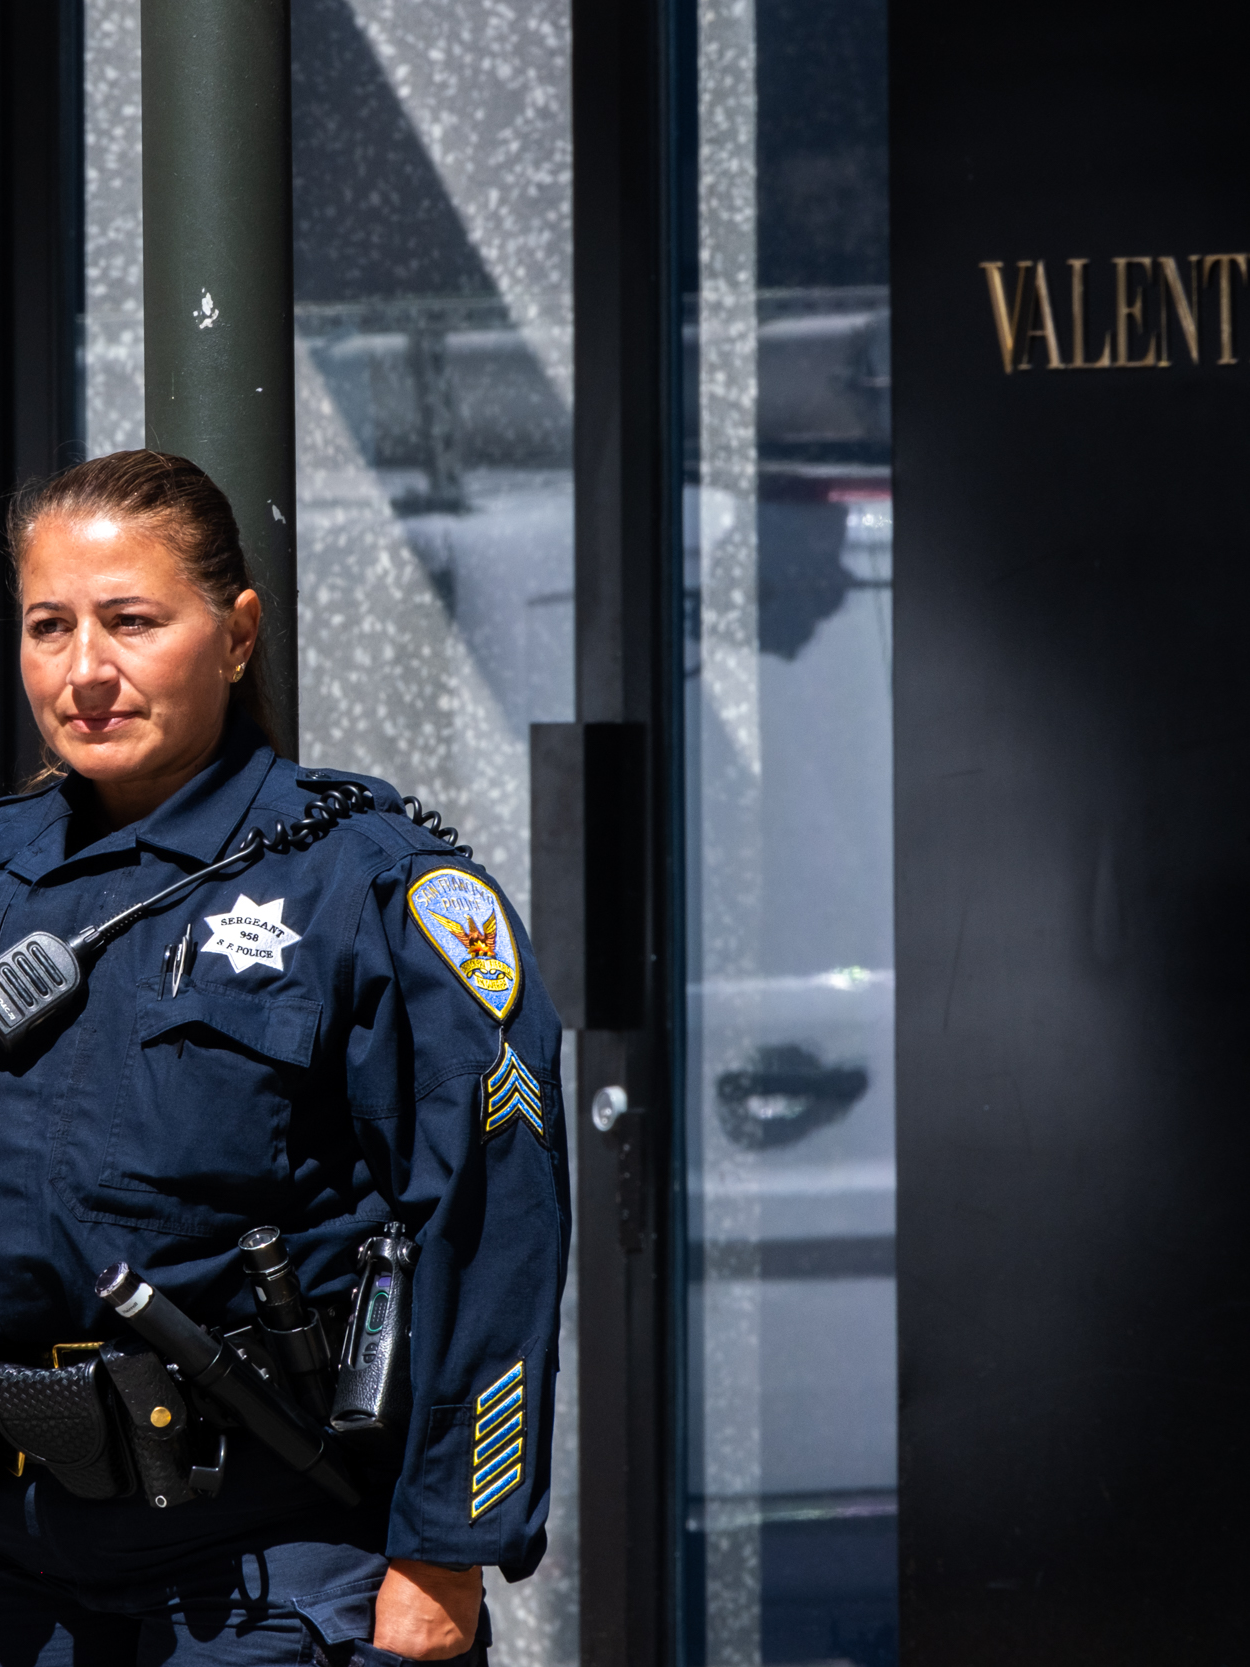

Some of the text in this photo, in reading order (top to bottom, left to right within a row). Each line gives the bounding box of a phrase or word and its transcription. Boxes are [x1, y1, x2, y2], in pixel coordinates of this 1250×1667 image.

[978, 254, 1250, 375] VALENT
[415, 882, 440, 907] SAN
[220, 916, 285, 939] SERGEANT
[239, 930, 260, 943] 958
[235, 945, 274, 959] POLICE
